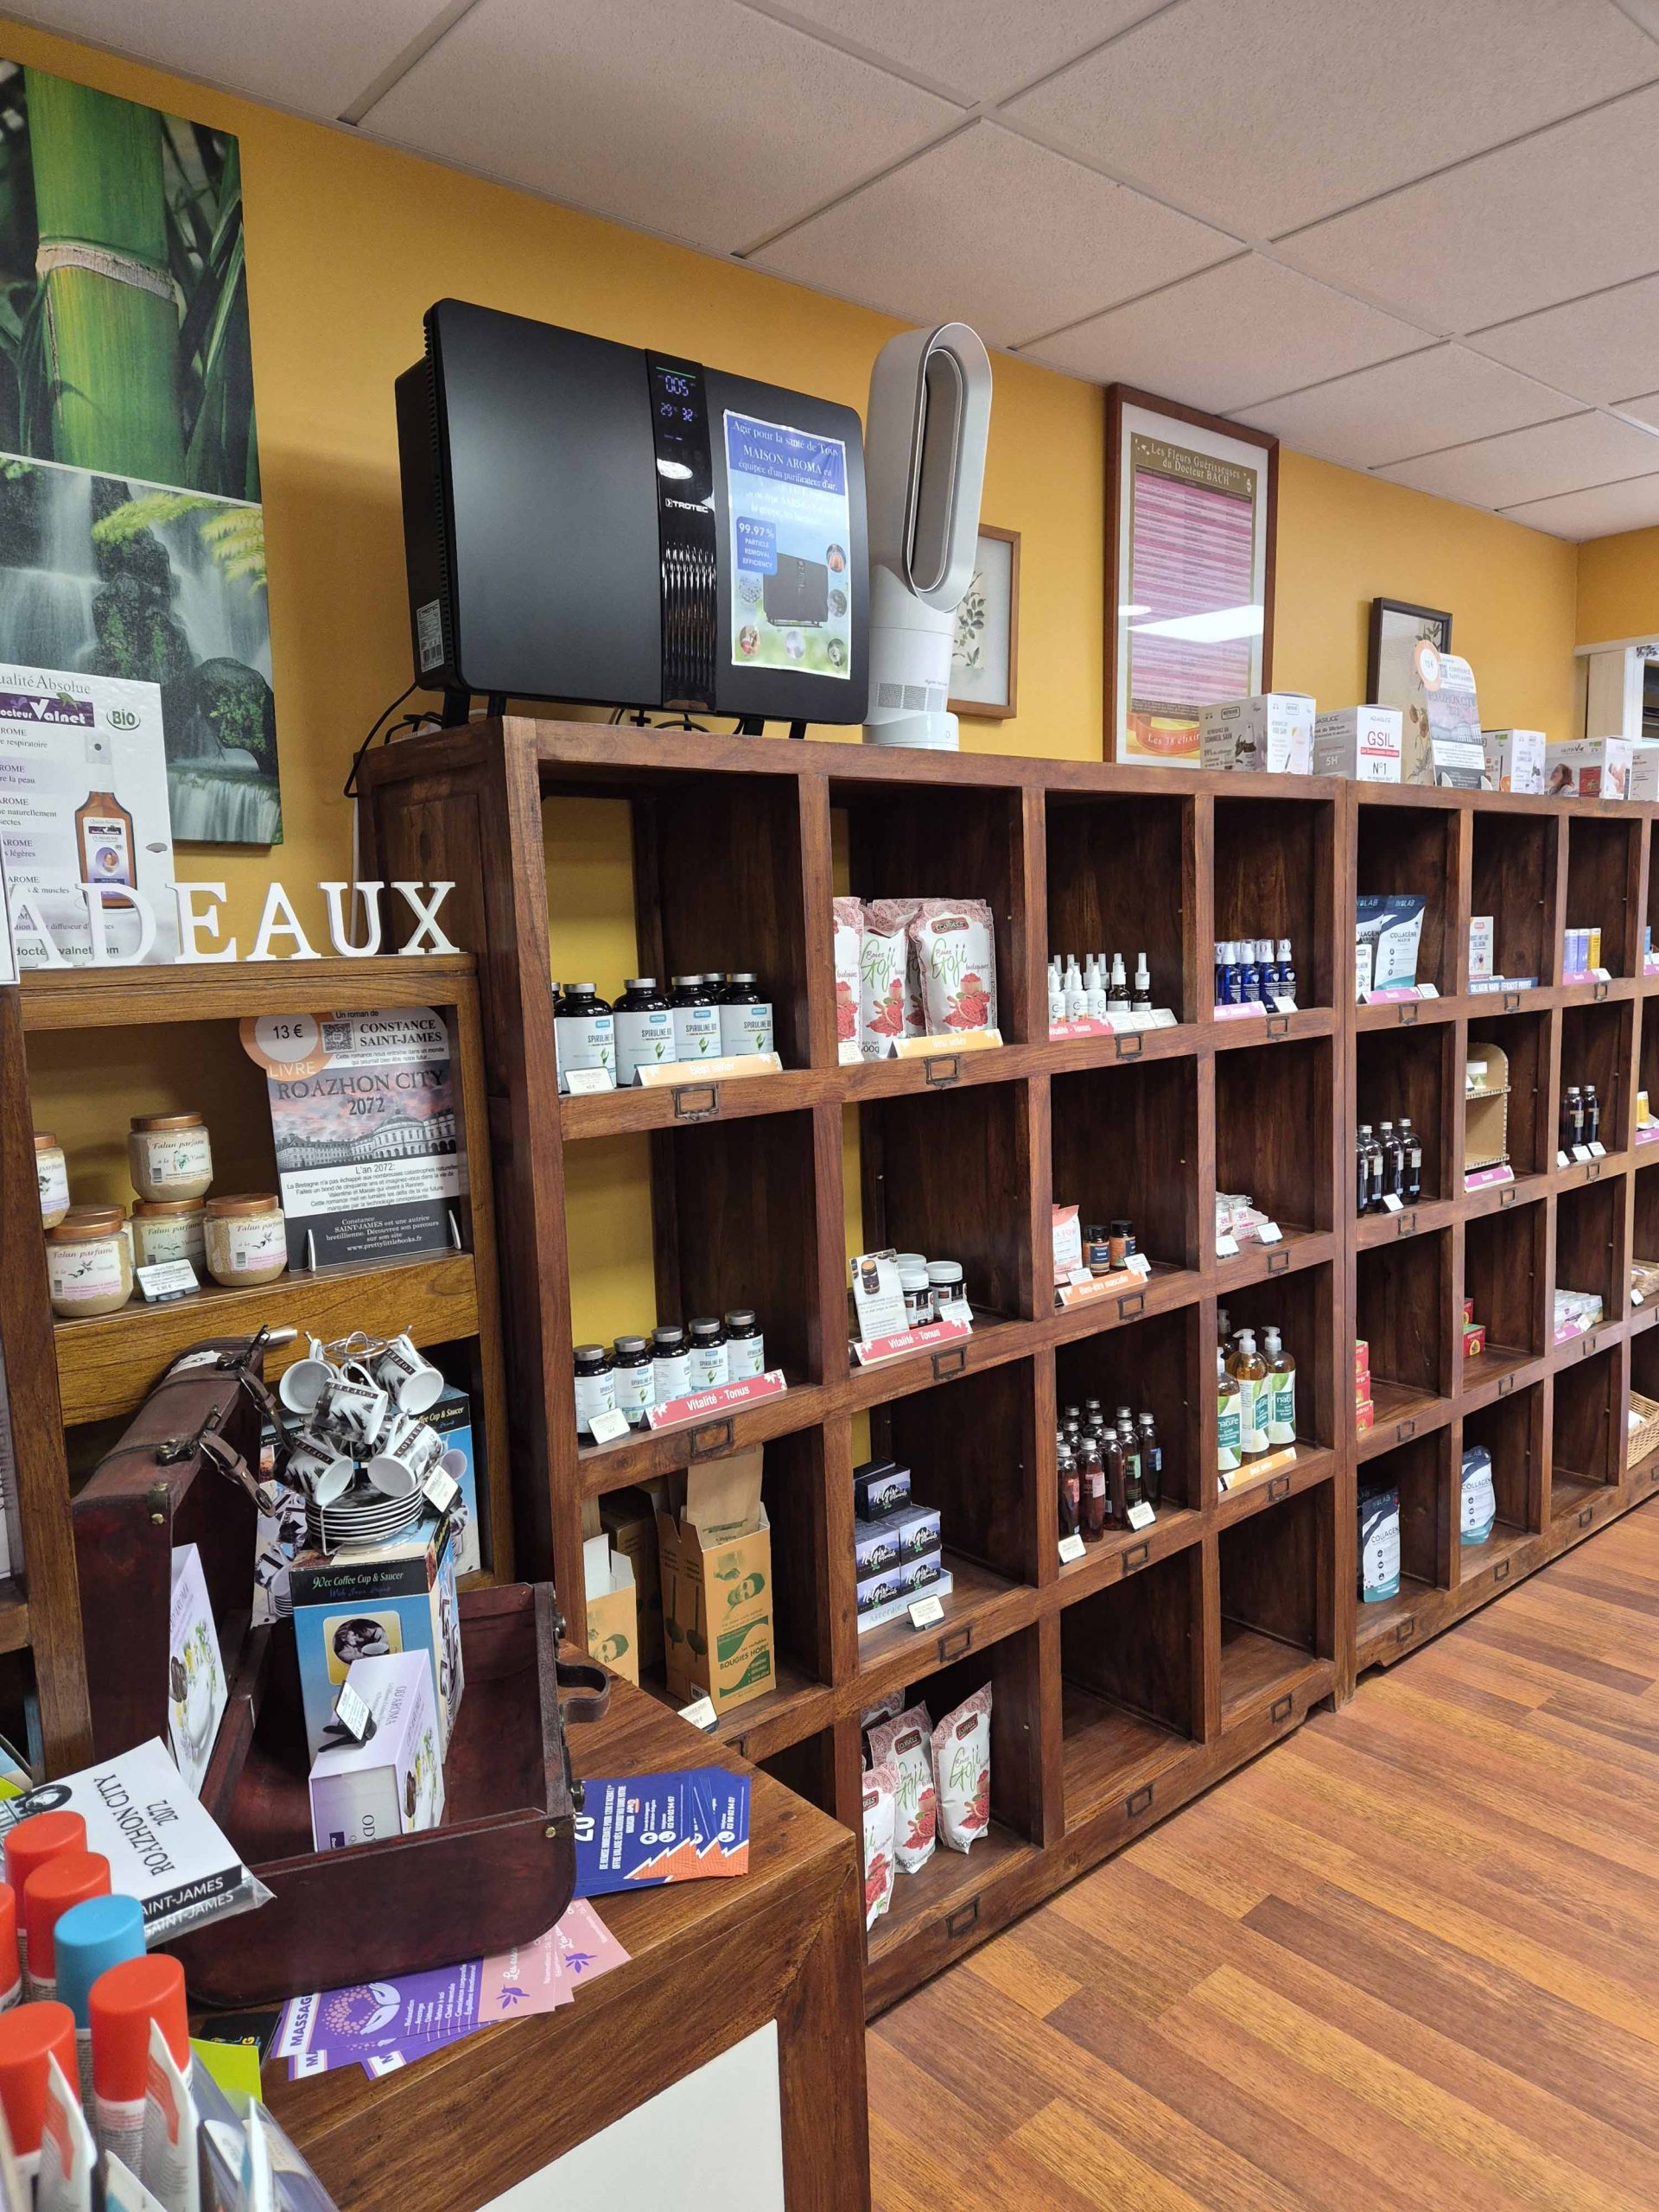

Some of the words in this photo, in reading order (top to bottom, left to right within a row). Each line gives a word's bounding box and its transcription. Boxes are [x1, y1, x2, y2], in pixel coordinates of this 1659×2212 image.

[665, 375, 689, 397] 005
[733, 421, 751, 434] Agir
[753, 429, 773, 441] pour
[776, 432, 782, 443] la
[785, 436, 804, 448] santé
[807, 441, 817, 451] de
[743, 444, 784, 465] MAISON
[786, 457, 822, 474] AROMA
[1151, 442, 1165, 457] Les
[1167, 448, 1192, 466] Fleurs
[1162, 457, 1172, 469] du
[1175, 461, 1205, 479] Docteur
[1206, 471, 1230, 486] BACH
[672, 499, 709, 513] TROTEC
[738, 522, 764, 536] 99.97
[744, 537, 769, 548] PARTICLE
[744, 548, 771, 558] REMOVAL
[742, 557, 772, 569] EFFICIENCY
[37, 675, 91, 694] Absolue
[29, 699, 86, 724] Valnet
[7, 740, 48, 749] respiratoire
[1147, 733, 1162, 746] Les
[1166, 736, 1174, 747] 38
[1367, 730, 1395, 748] GSIL
[10, 849, 35, 858] légères
[272, 1025, 289, 1039] 13
[293, 1024, 303, 1039] €
[359, 1020, 436, 1034] CONSTANCE
[641, 1028, 666, 1038] SPIRULINE
[685, 1023, 710, 1033] SPIRULINE
[744, 1020, 766, 1029] SPIRULINE
[359, 1032, 442, 1047] SAINT-JAMES
[268, 1062, 316, 1078] LIVRE
[277, 1071, 391, 1101] ROAZHON
[395, 1070, 445, 1090] CITY
[347, 1097, 385, 1116] 2072
[296, 1180, 319, 1190] Bretagne
[328, 1178, 339, 1186] pas
[340, 1175, 361, 1185] échappé
[372, 1172, 404, 1180] nombreuses
[404, 1167, 435, 1178] catastrophes
[355, 1165, 372, 1175] L'an
[321, 1184, 335, 1192] bond
[326, 1198, 349, 1206] romance
[334, 1221, 384, 1233] SAINT-JAMES
[341, 1216, 376, 1225] Constance
[366, 1226, 400, 1236] Découvrez
[412, 1220, 440, 1230] parcours
[346, 1235, 423, 1251] www.prettylittlebooks.fr
[888, 1332, 915, 1350] Vitalité
[918, 1327, 941, 1341] Tonus
[686, 1394, 718, 1412] Vitalité
[723, 1384, 750, 1401] Tonus
[429, 1412, 441, 1421] Cup
[446, 1406, 465, 1417] Saucer
[397, 1424, 424, 1455] COFFEE
[312, 1576, 332, 1590] 90cc
[334, 1575, 356, 1586] Coffee
[357, 1574, 372, 1585] Cup
[372, 1573, 378, 1582] &
[379, 1572, 404, 1581] Saucer
[720, 1652, 749, 1670] BOUGIES
[385, 1685, 407, 1726] OD'AROMA
[93, 1774, 130, 1810] CITY
[145, 1799, 179, 1827] 2072
[113, 1807, 176, 1876] ROAZHON
[454, 1988, 465, 2017] Conscience
[290, 1993, 315, 2047] MASSAG
[404, 1999, 416, 2027] Relaxation
[415, 2003, 425, 2024] Ancrage
